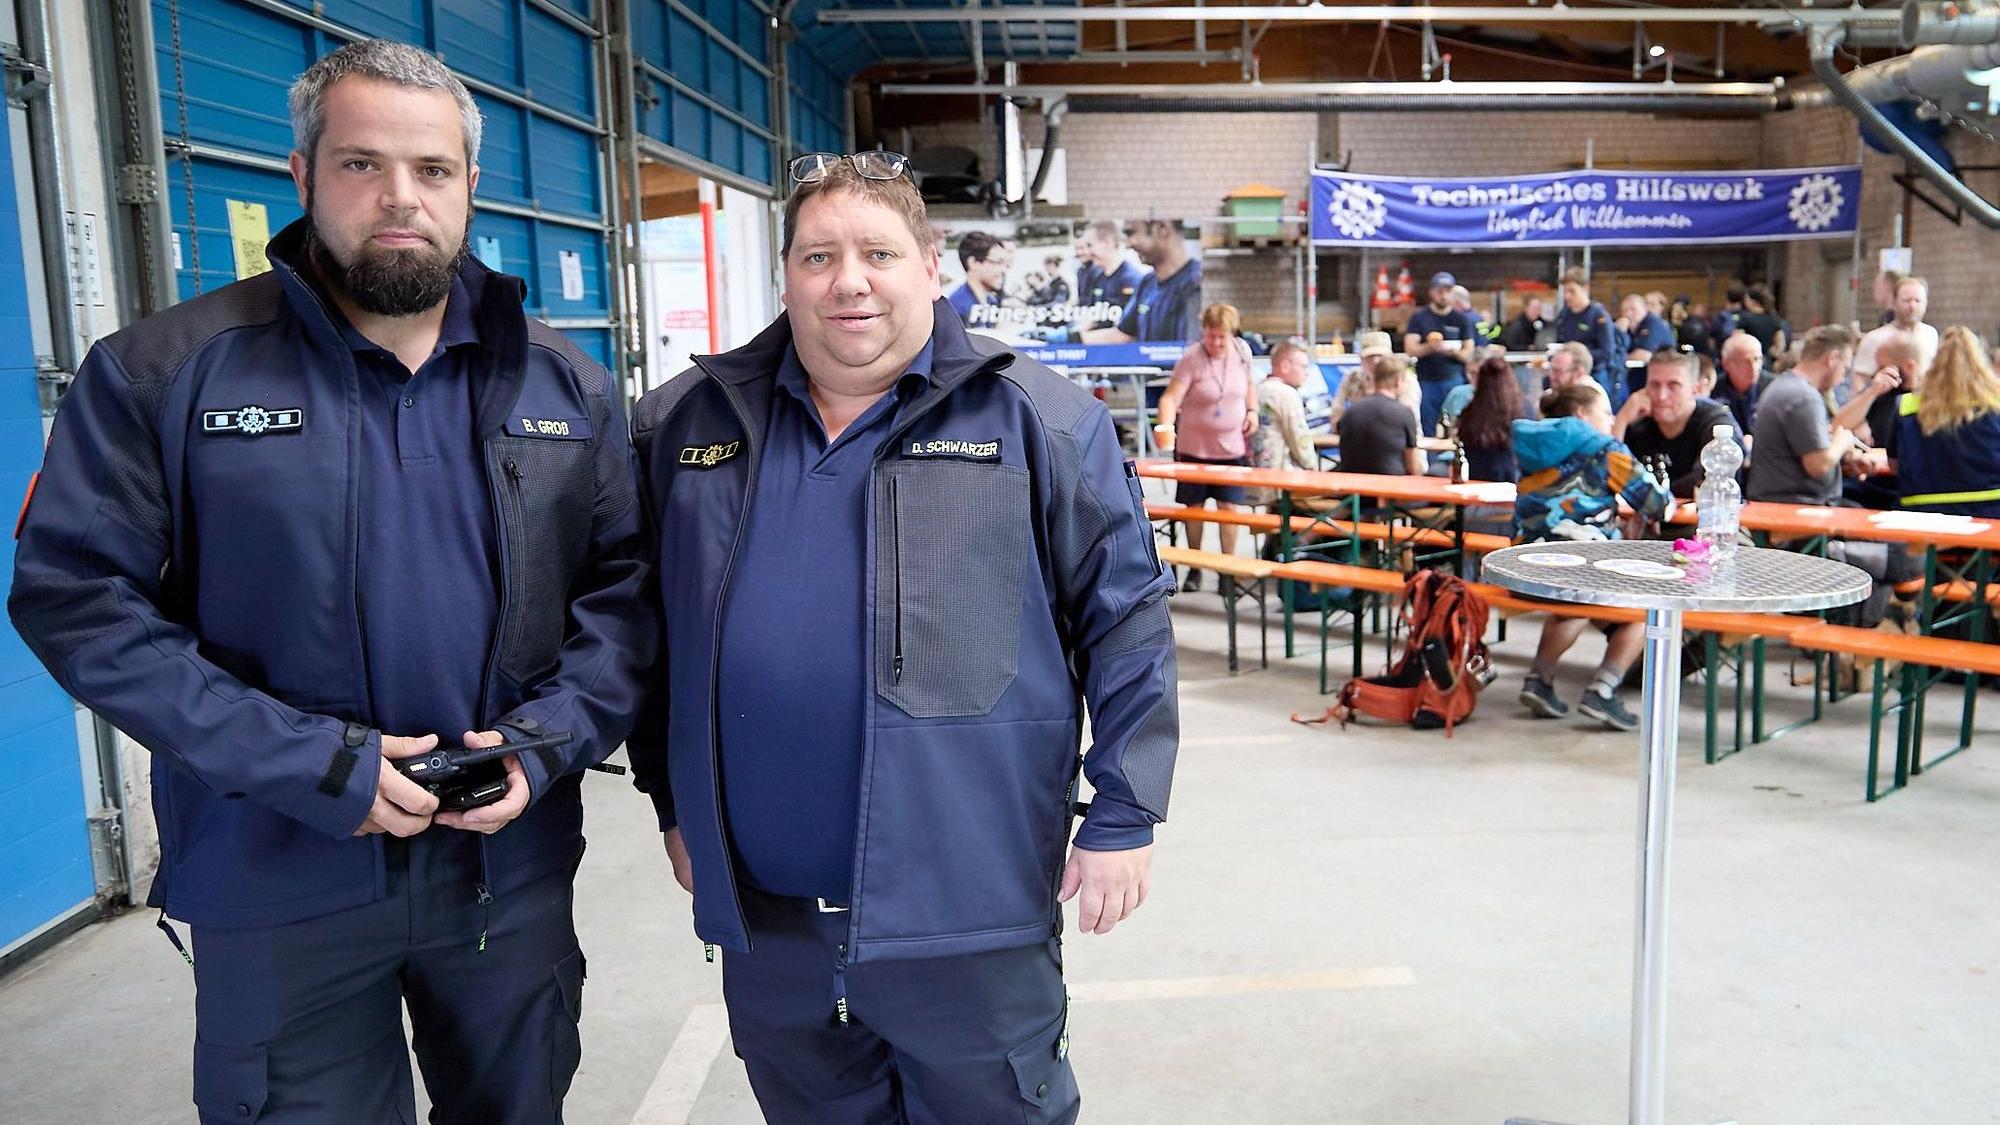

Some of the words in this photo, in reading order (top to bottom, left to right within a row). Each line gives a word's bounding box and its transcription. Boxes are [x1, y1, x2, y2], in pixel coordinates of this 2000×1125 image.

[1411, 182, 1607, 207] Technisches
[1616, 178, 1765, 201] Hilfswerk
[1570, 204, 1693, 229] Willkommen
[521, 418, 538, 433] B.
[911, 442, 924, 454] D.
[925, 440, 998, 457] SCHWARZER
[836, 997, 848, 1023] THW
